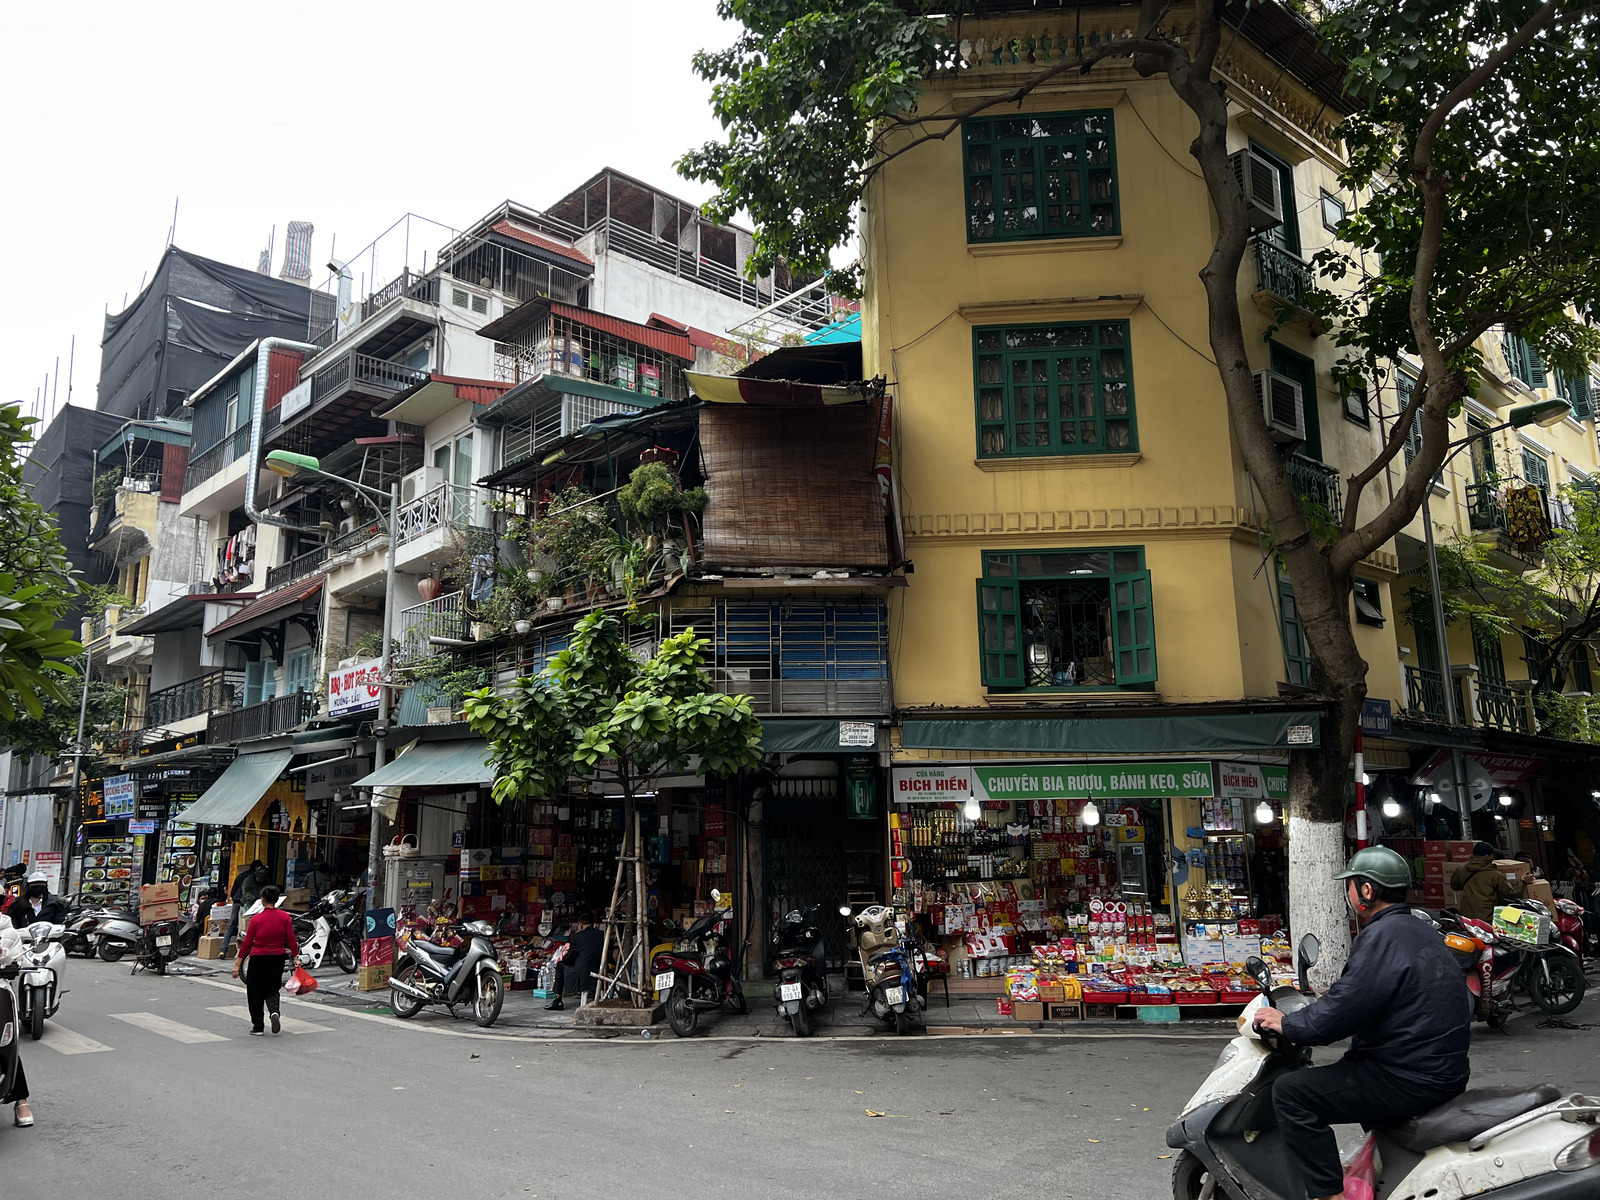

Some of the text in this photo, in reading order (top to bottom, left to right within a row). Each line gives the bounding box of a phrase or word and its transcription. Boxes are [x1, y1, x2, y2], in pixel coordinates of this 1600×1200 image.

[344, 672, 354, 691] HOT
[900, 777, 931, 792] BÍCH
[988, 774, 1038, 792] CHUYÊN
[1043, 776, 1064, 791] BIA
[1110, 772, 1146, 790] BÁNH
[1150, 774, 1179, 792] KẸO,
[1182, 770, 1210, 788] SỮA
[105, 784, 120, 796] BOOKING
[121, 783, 132, 794] OFFICE
[455, 834, 462, 844] 75
